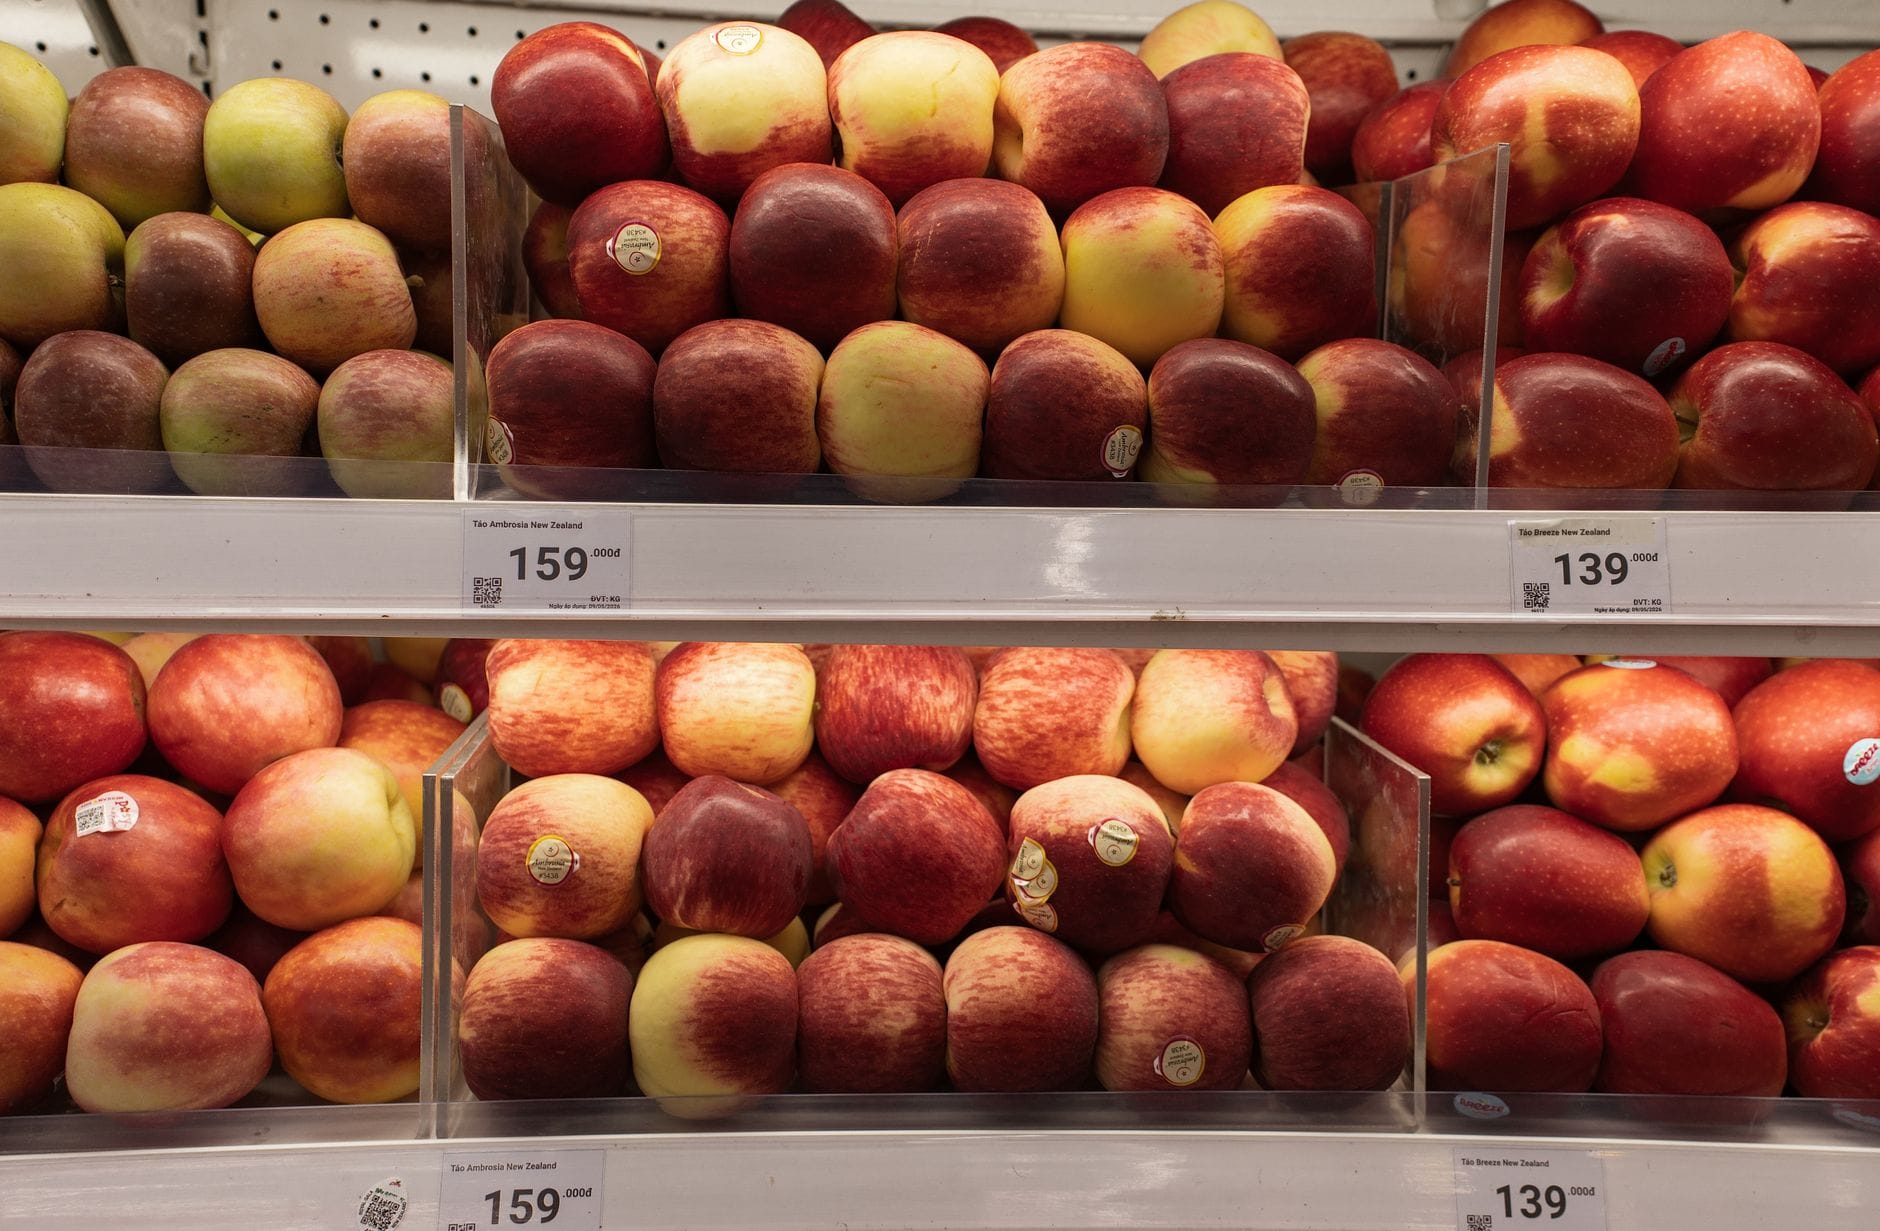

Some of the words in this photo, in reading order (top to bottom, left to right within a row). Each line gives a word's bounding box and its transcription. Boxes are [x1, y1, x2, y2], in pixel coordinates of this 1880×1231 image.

[472, 520, 488, 528] Táo
[489, 520, 529, 529] Ambrosia
[530, 521, 549, 529] New
[550, 521, 583, 530] Zealand
[1519, 528, 1533, 537] Táo
[1534, 529, 1560, 537] Breeze
[1561, 529, 1579, 537] New
[1579, 528, 1611, 537] Zealand
[509, 546, 588, 581] 159
[590, 548, 621, 558] .000đ
[1554, 552, 1629, 586] 139
[1630, 553, 1659, 563] .000đ
[609, 595, 621, 603] KG
[451, 1164, 465, 1172] Táo
[467, 1163, 505, 1171] Ambrosia
[525, 1162, 557, 1170] Zealand
[1461, 1158, 1475, 1166] Táo
[1502, 1159, 1519, 1167] New
[1520, 1160, 1550, 1168] Zealand
[485, 1187, 560, 1225] 159
[562, 1188, 592, 1198] .000đ
[1496, 1184, 1566, 1219] 139
[1567, 1186, 1595, 1196] .000đ
